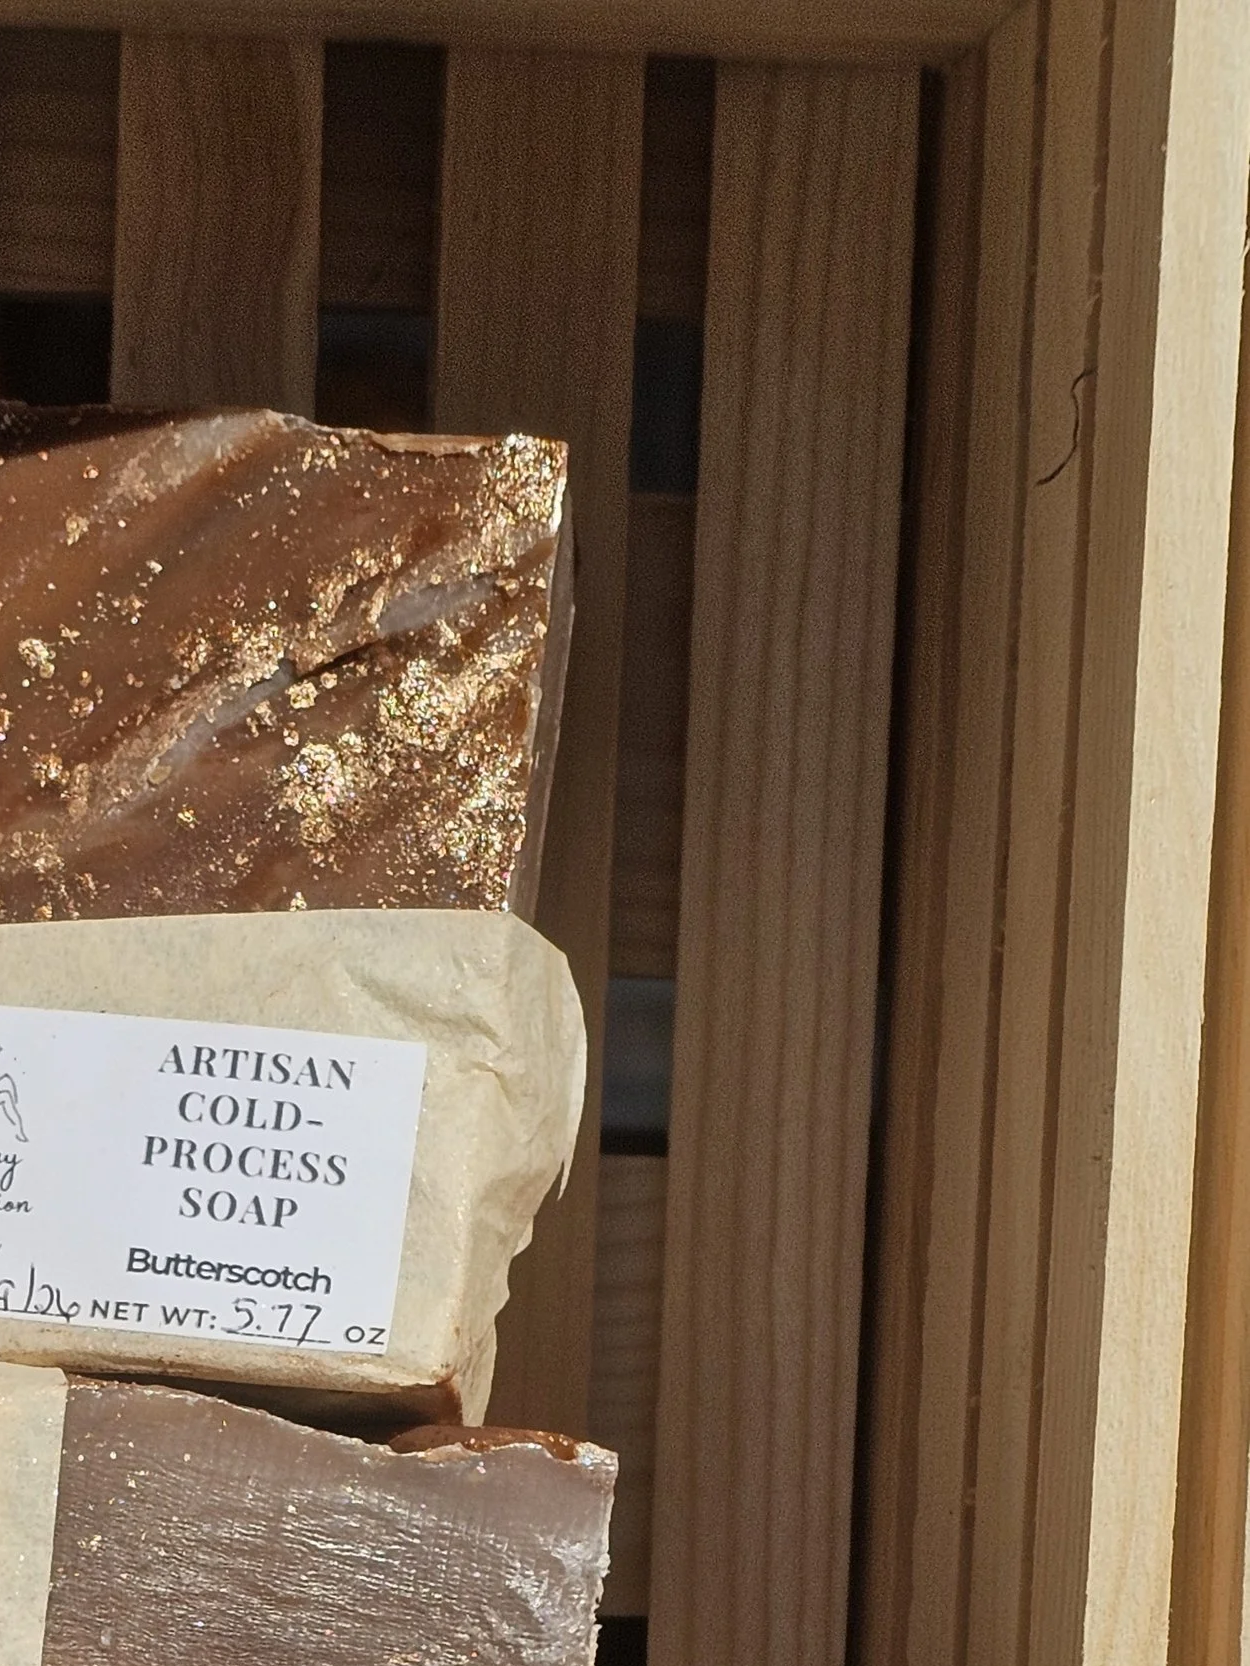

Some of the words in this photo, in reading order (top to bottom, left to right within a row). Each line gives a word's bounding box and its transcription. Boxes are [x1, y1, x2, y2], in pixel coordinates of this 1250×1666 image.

[157, 1043, 356, 1092] ARTISAN
[177, 1091, 324, 1134] COLD-
[142, 1134, 349, 1187] PROCESS
[178, 1187, 299, 1230] SOAP
[126, 1247, 333, 1294] Butterscotch
[90, 1299, 150, 1322] NET
[161, 1305, 217, 1330] WT:
[232, 1298, 323, 1346] 5.77
[345, 1325, 386, 1346] OZ
